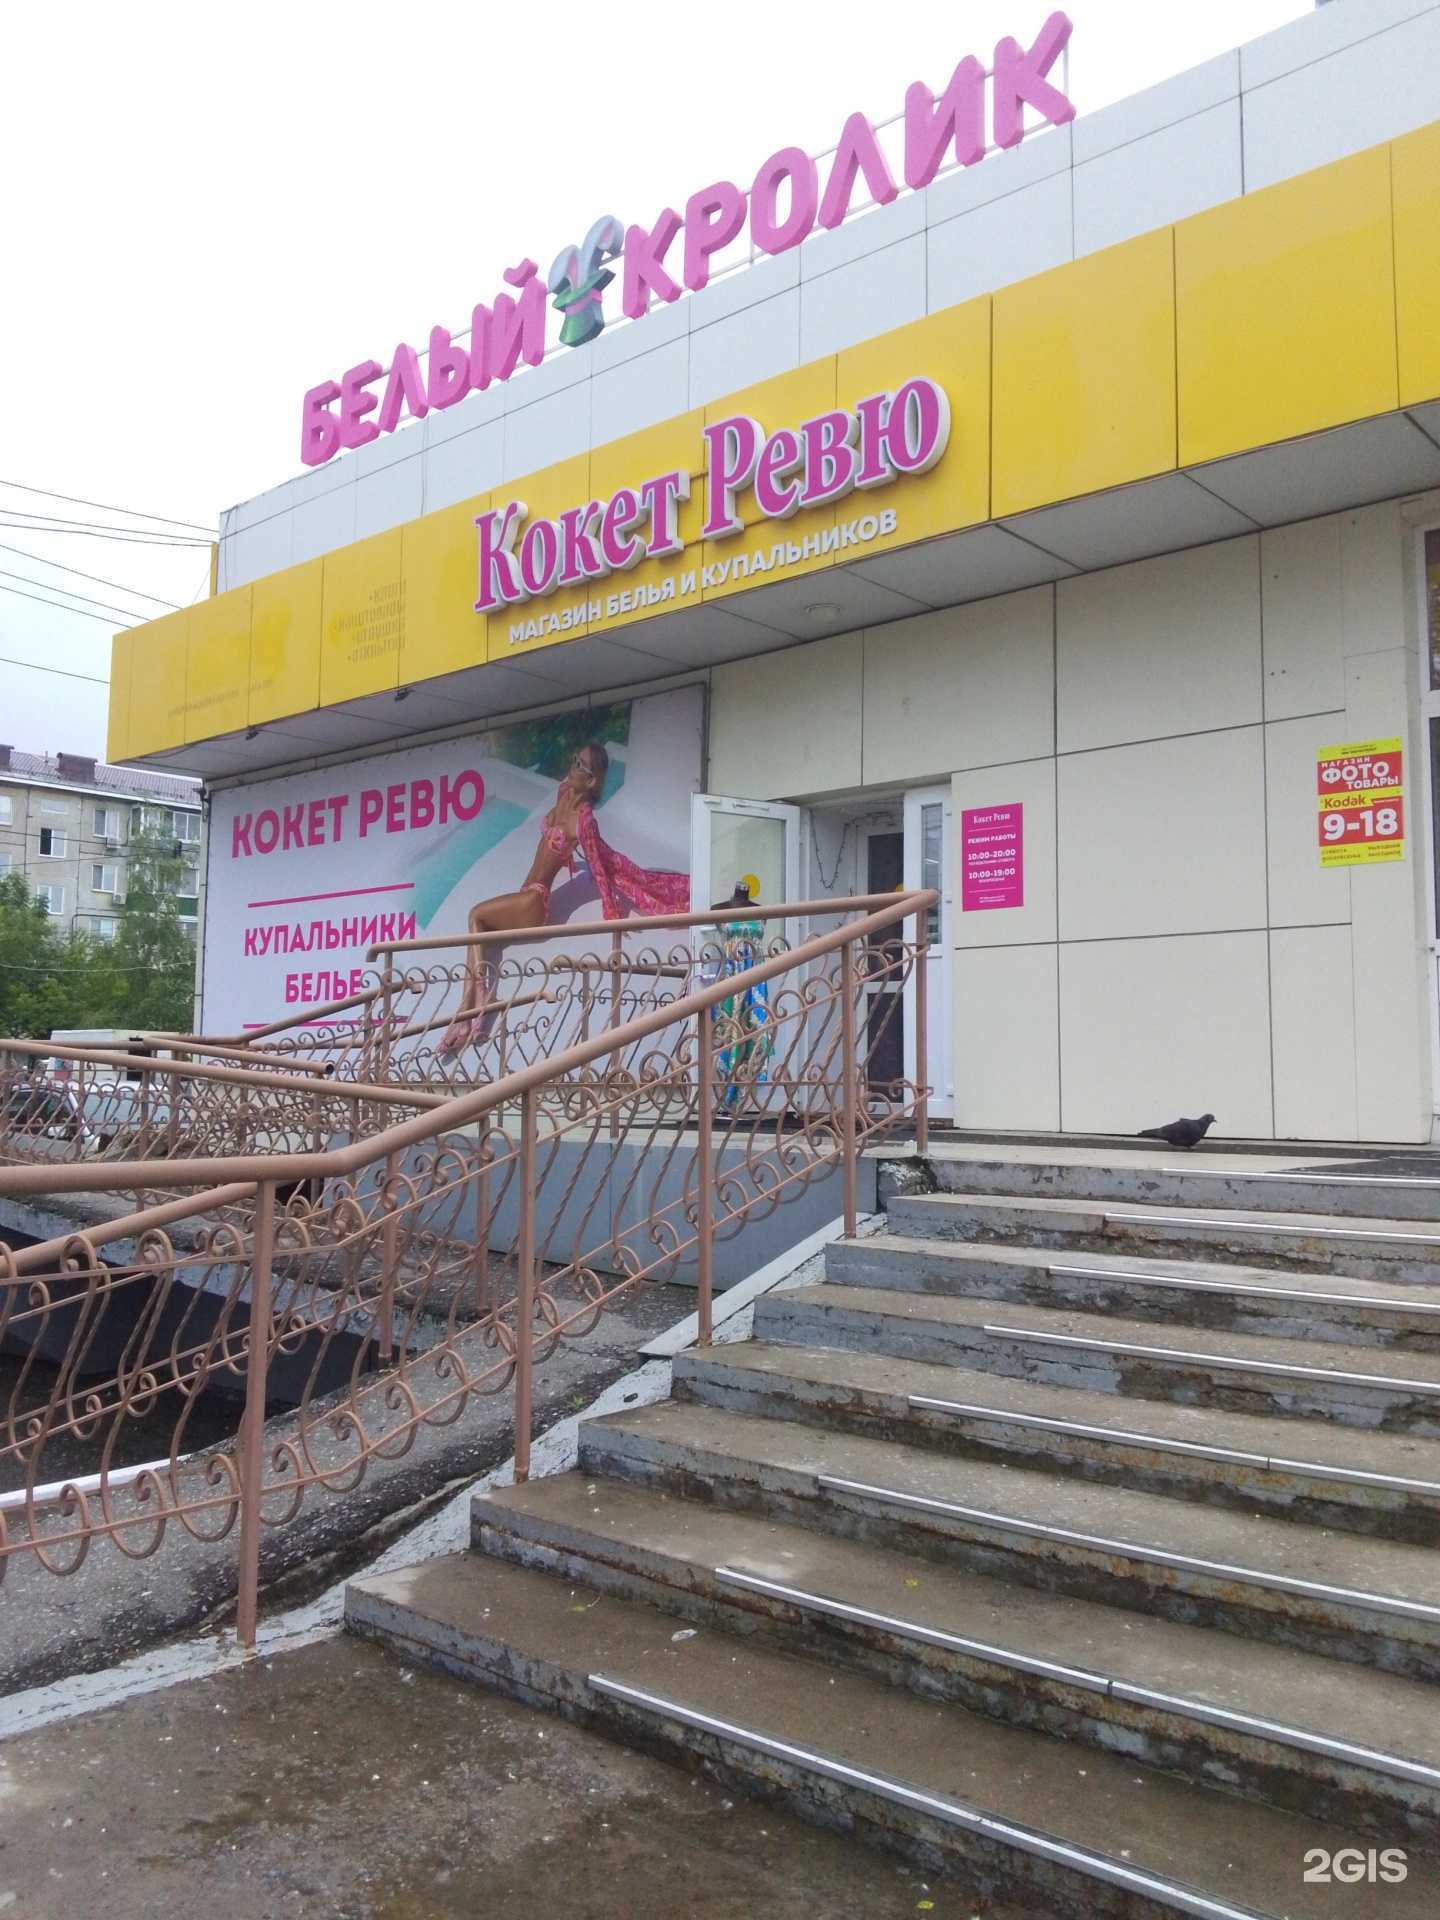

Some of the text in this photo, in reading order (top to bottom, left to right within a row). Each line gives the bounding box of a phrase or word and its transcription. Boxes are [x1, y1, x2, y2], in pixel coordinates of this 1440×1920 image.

[301, 10, 1077, 467] БЕЛЫЙ КРОЛИК
[473, 376, 951, 614] Кокет Ревю
[508, 509, 897, 644] МАГАЗИН БЕЛЬЯ И КУПАЛЬНИКОВ
[1321, 756, 1371, 768] МАГАЗИН
[1322, 761, 1390, 784] ФОТО
[1347, 776, 1399, 790] ТОВАРЫ
[232, 769, 485, 859] КОКЕТ РЕВЮ
[1324, 795, 1366, 809] Kodak
[1323, 808, 1398, 840] 9-18
[244, 911, 416, 957] КУПАЛЬНИКИ
[285, 968, 363, 1004] БЕЛЬЕ
